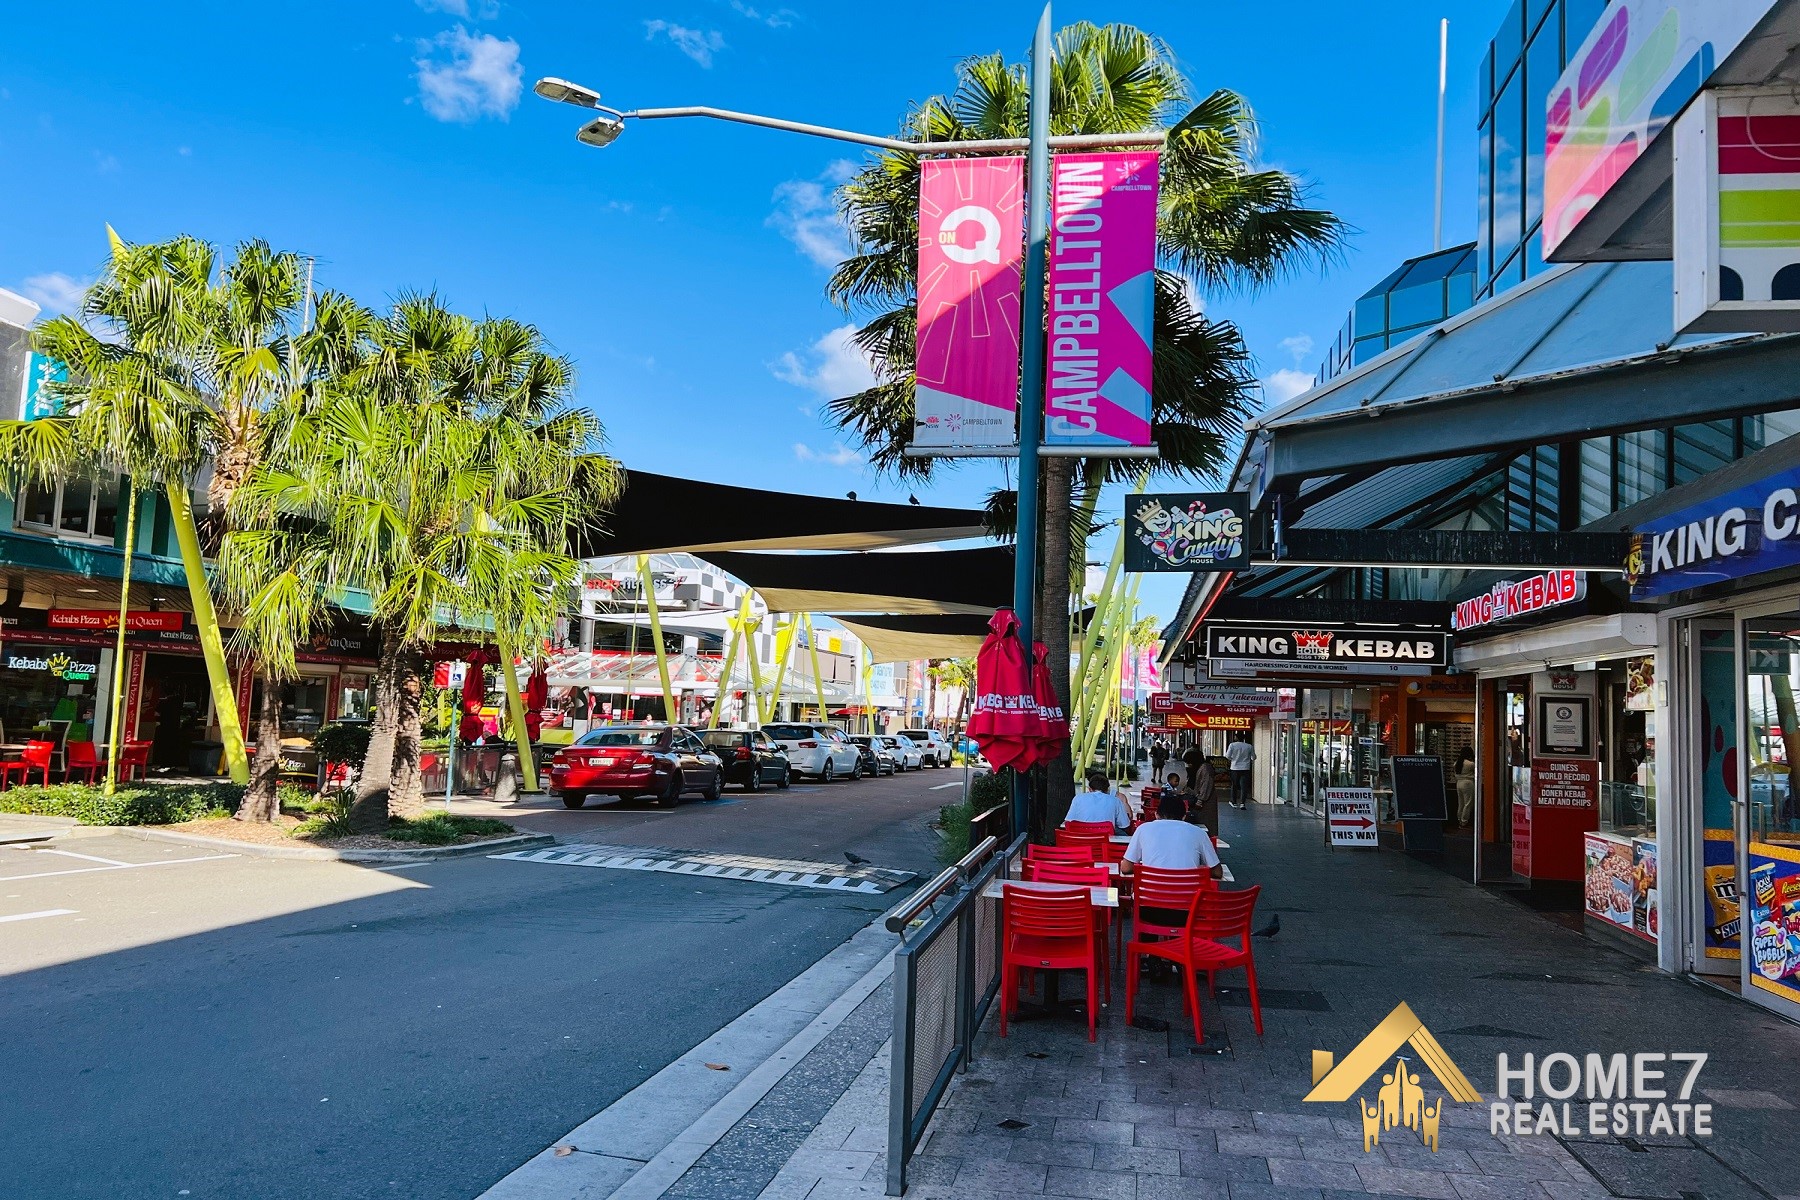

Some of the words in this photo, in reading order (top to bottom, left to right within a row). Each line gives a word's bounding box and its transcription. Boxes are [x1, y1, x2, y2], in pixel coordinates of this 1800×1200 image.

[1111, 184, 1152, 192] CAMPBELLTOWN
[938, 231, 956, 245] ON
[939, 205, 1000, 264] Q
[1051, 161, 1104, 437] CAMPBELLTOWN
[962, 418, 1002, 426] CAMPBELLTOWN
[1176, 517, 1242, 540] KING
[1651, 507, 1746, 574] KING
[1764, 488, 1800, 541] C
[1168, 537, 1234, 564] Candy
[1456, 593, 1492, 631] KING
[1506, 570, 1576, 616] KEBAB
[52, 614, 80, 624] Kebabs
[80, 615, 100, 624] Pizza
[136, 616, 162, 627] Queen
[340, 638, 360, 650] Queen
[1218, 636, 1288, 655] KING
[1335, 640, 1435, 659] KEBAB
[1296, 647, 1330, 655] HOUSE
[8, 656, 48, 670] Kebabs
[70, 661, 96, 674] Pizza
[62, 670, 90, 680] Queen
[129, 684, 138, 706] Pizza
[1186, 692, 1216, 700] Bakery
[1229, 694, 1275, 703] Takeaway
[1208, 716, 1250, 725] DENTIST
[288, 760, 306, 768] Pizza
[1550, 764, 1578, 772] GUINESS
[1538, 772, 1562, 780] WORLD
[1564, 773, 1590, 782] RECORD
[1542, 789, 1563, 798] DONER
[1564, 790, 1586, 798] KEBAB
[1538, 797, 1556, 805] MEAT
[1556, 798, 1570, 806] AND
[1572, 798, 1592, 806] CHIPS
[1330, 804, 1347, 814] OPEN
[1347, 804, 1354, 814] 7
[1332, 831, 1354, 840] THIS
[1356, 831, 1376, 840] WAY
[1757, 874, 1770, 889] JOLLY
[1754, 936, 1776, 950] SUPER
[1757, 948, 1786, 963] BUBBLE
